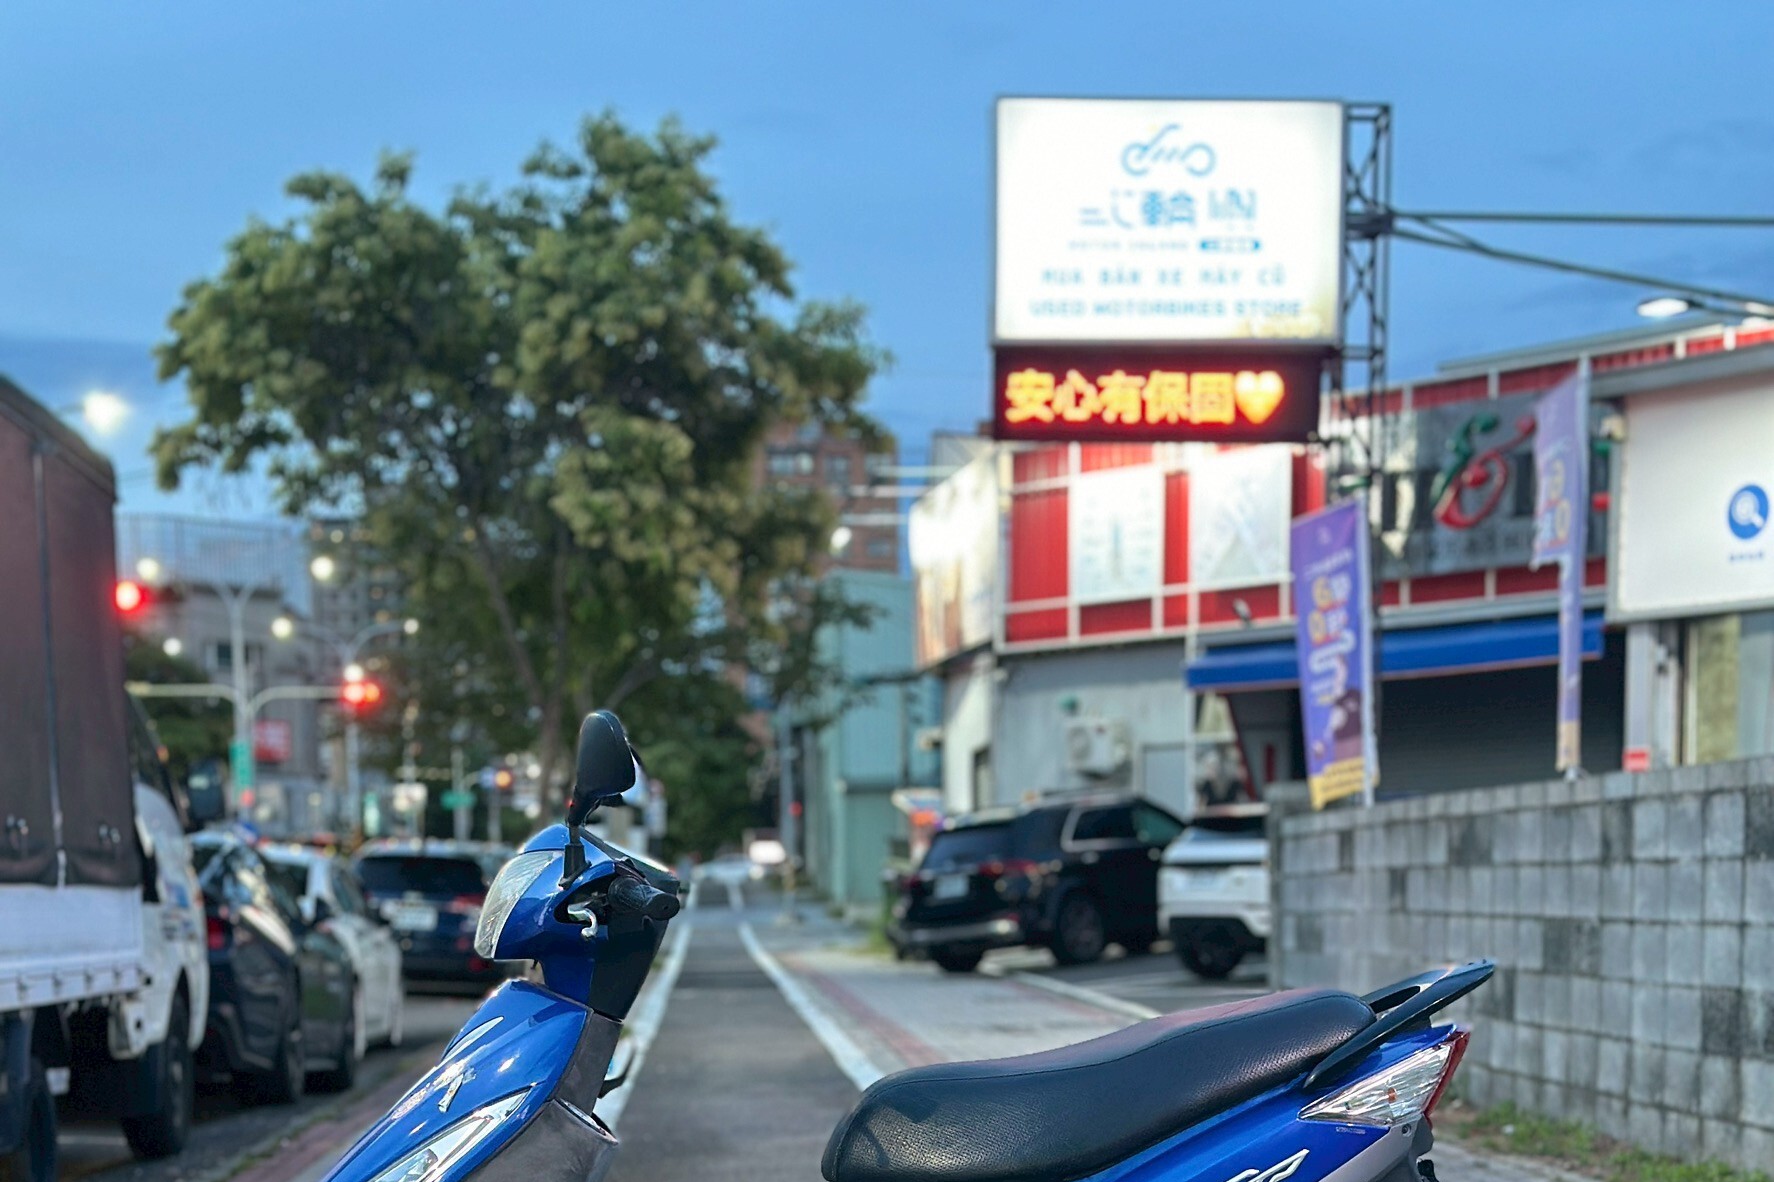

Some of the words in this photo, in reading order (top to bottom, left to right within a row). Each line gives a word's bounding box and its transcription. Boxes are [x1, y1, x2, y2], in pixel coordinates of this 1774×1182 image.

[1029, 298, 1087, 318] USED
[1092, 298, 1226, 318] MOTORBIKES
[1232, 298, 1303, 318] STORE
[1005, 367, 1236, 424] 安心有保固
